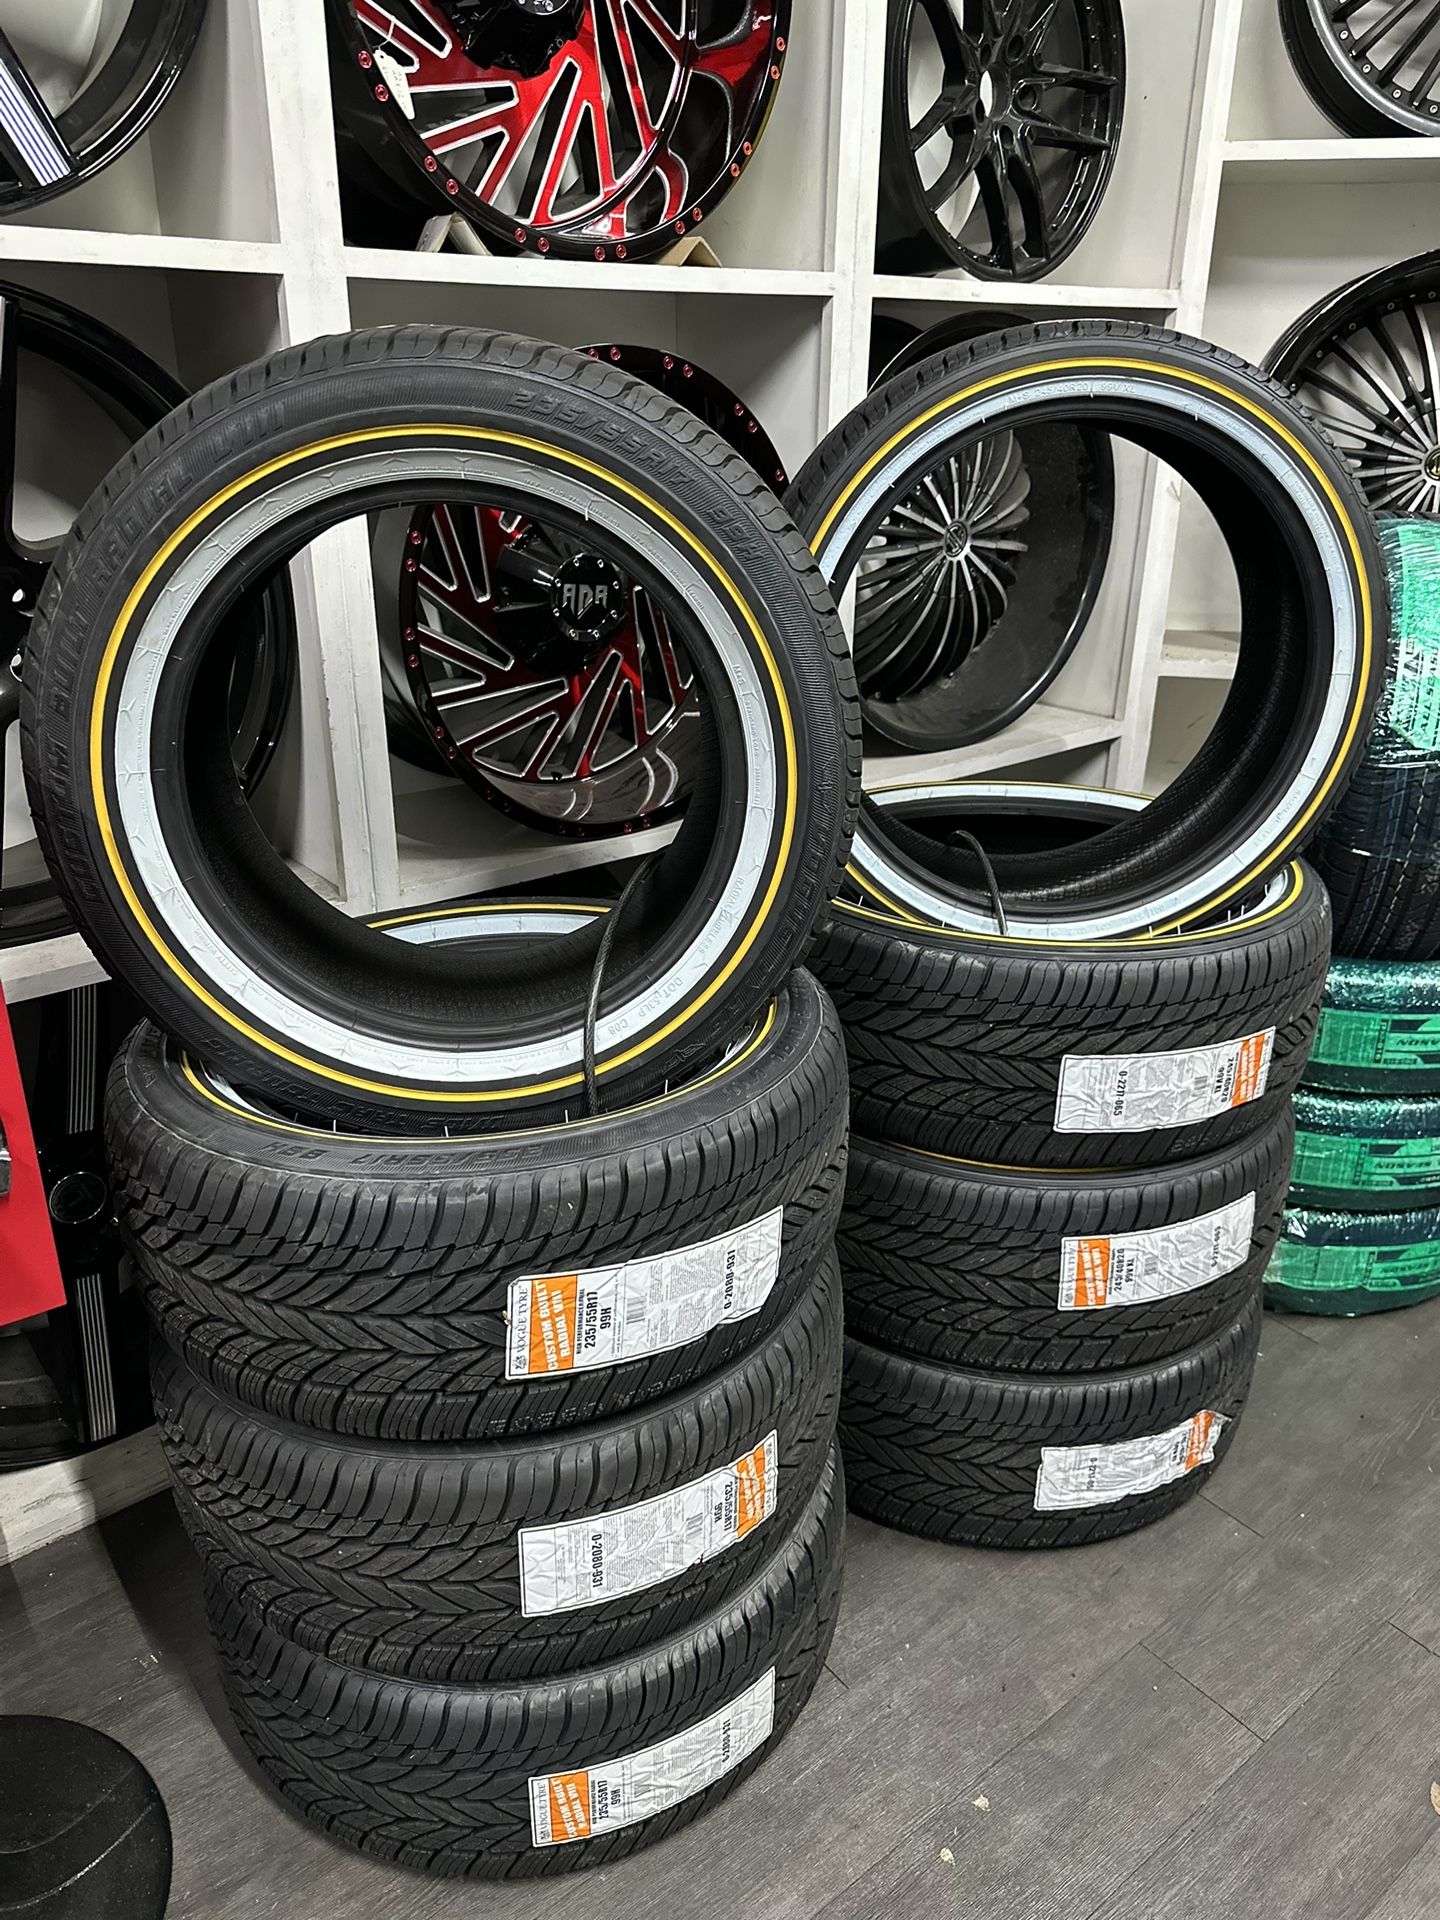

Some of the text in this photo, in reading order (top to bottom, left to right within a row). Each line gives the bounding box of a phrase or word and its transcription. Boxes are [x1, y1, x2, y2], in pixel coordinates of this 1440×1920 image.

[506, 389, 697, 490] 235/55R17
[661, 975, 685, 998] DOT
[722, 1248, 737, 1310] 0-2080-931
[516, 1287, 528, 1353] VOGUE TYRE
[534, 1281, 558, 1370] CUSTOM BUILT
[556, 1312, 571, 1359] RADIAL
[584, 1291, 598, 1349] 235/55R17
[600, 1306, 612, 1330] 99H
[723, 1481, 734, 1532] 235/55R17
[590, 1533, 603, 1589] 0-2080-931
[551, 1778, 578, 1838] CUSTOM BUILT
[597, 1780, 609, 1820] 235/55R17
[610, 1787, 622, 1806] 99H
